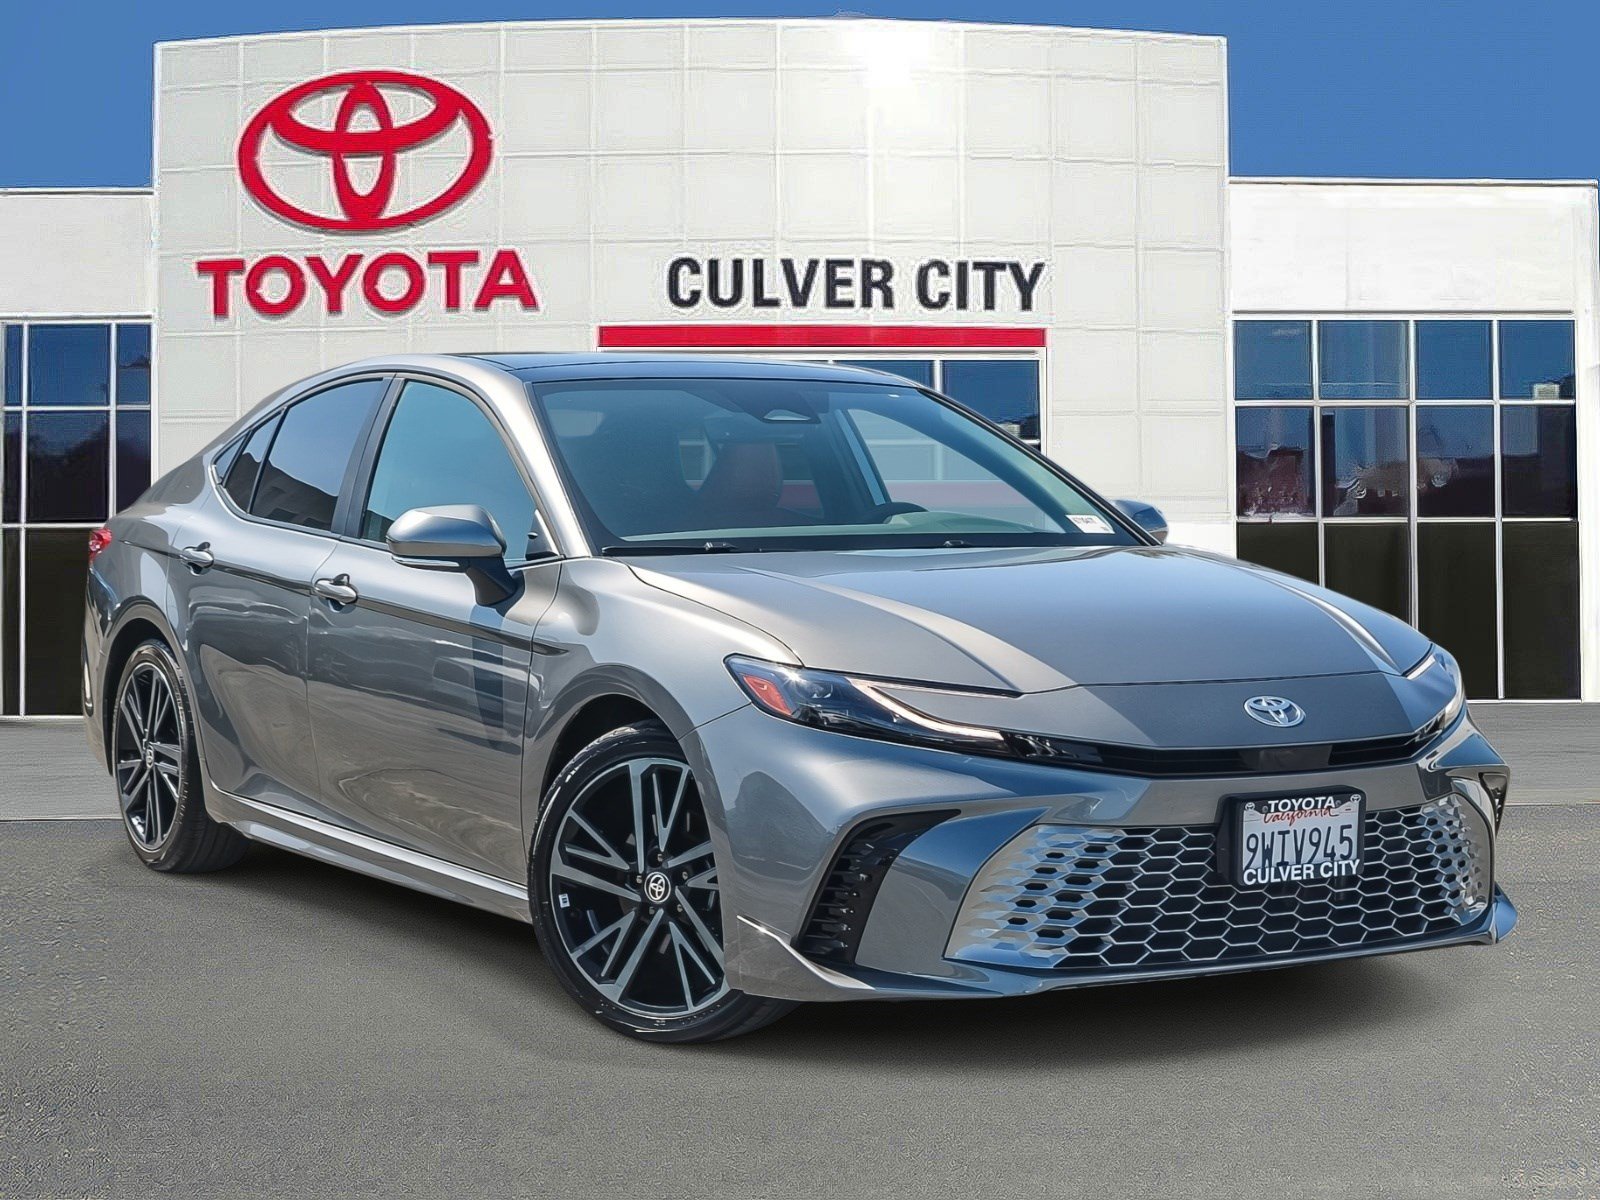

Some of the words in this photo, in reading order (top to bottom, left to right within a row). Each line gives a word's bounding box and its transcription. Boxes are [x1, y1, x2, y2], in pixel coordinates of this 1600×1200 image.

[195, 249, 540, 319] TOYOTA
[667, 256, 895, 309] CULVER
[915, 258, 1046, 311] CITY
[1268, 796, 1336, 813] TOYOTA
[1245, 824, 1353, 871] 9WIV945
[1243, 863, 1314, 886] CULVER
[1320, 858, 1360, 879] CITY
